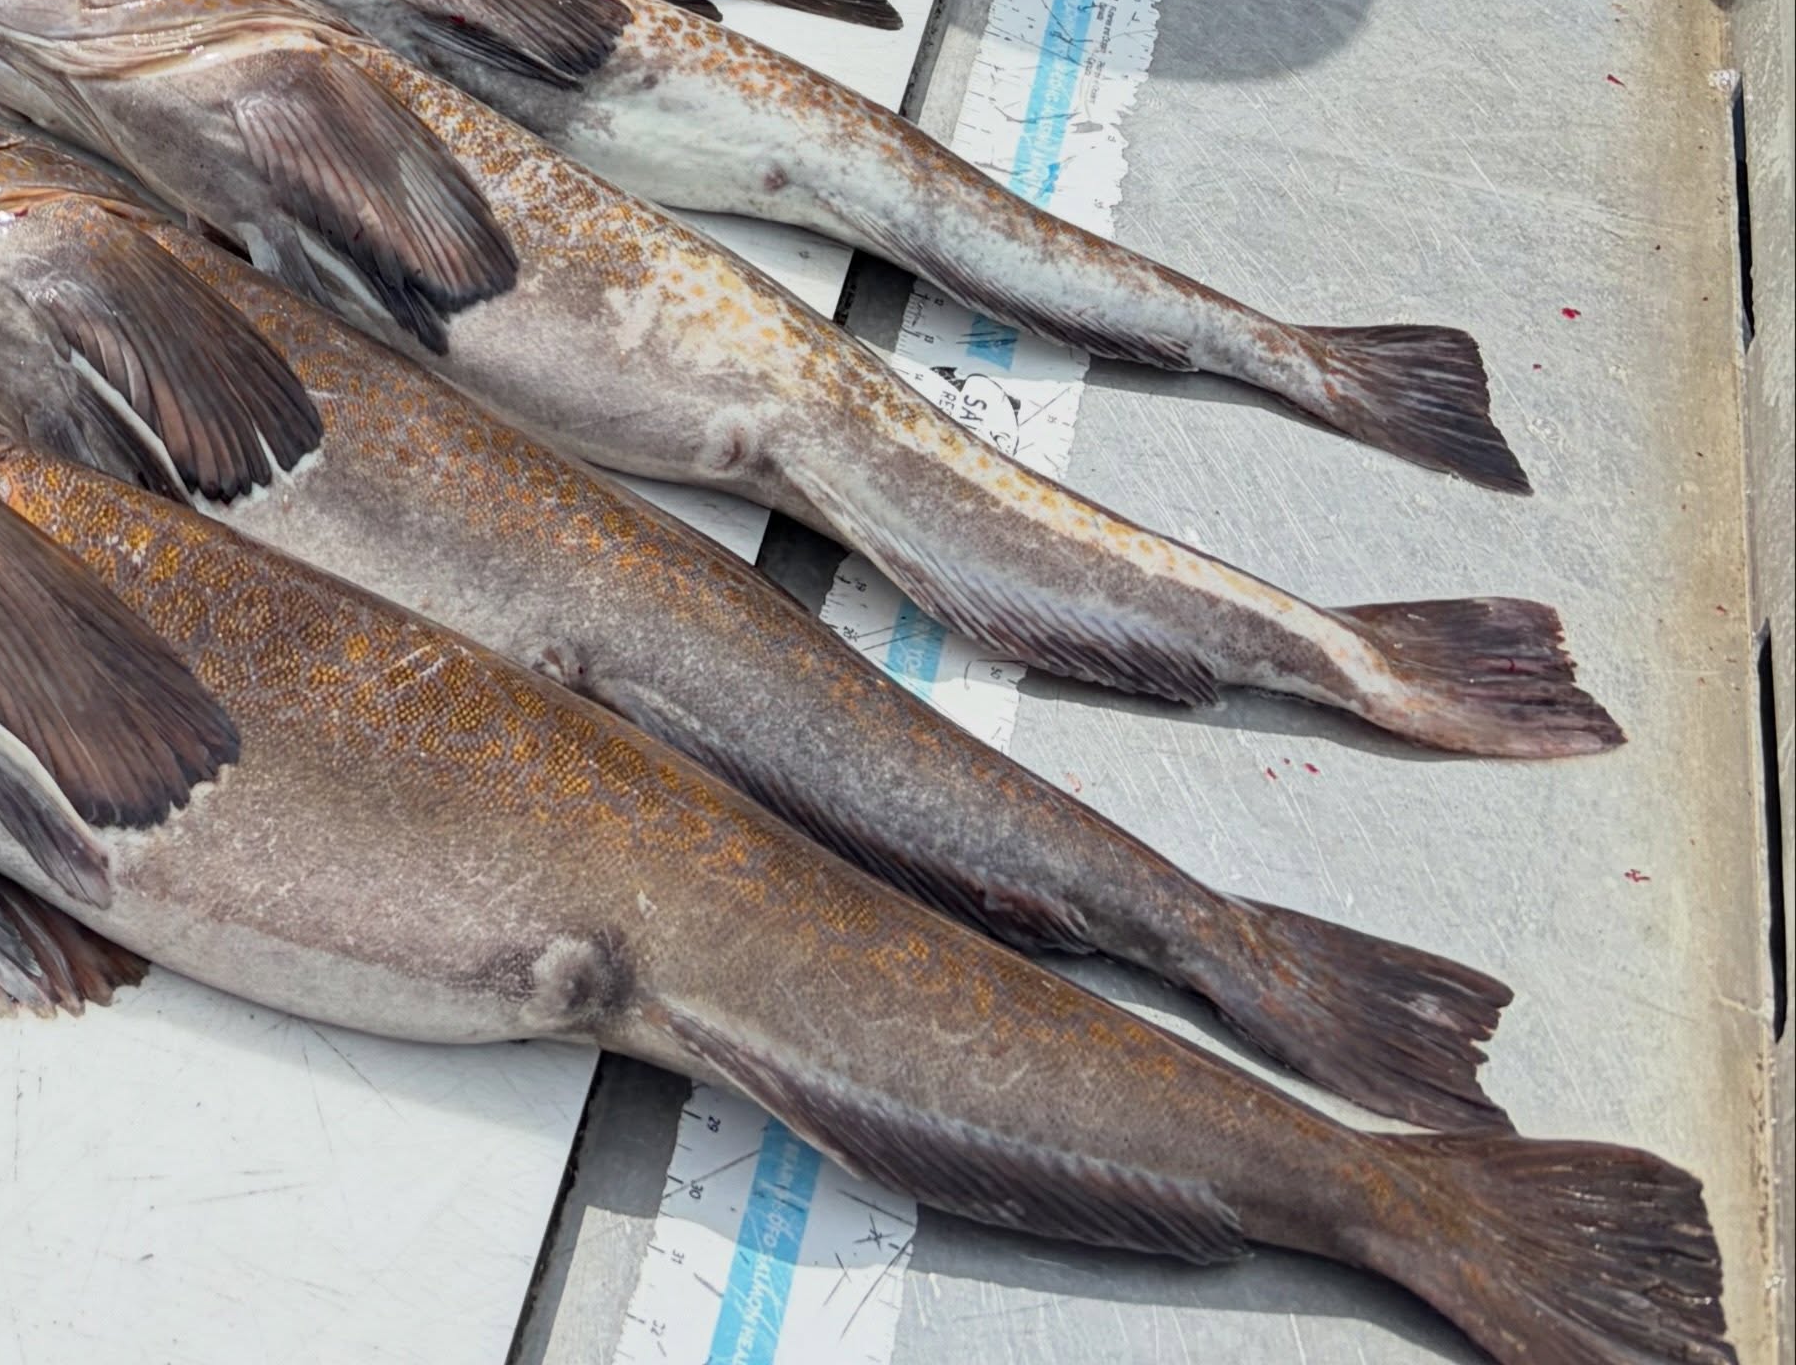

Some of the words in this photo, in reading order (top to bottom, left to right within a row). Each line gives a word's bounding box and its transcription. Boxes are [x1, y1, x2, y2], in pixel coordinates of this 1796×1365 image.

[706, 1115, 722, 1133] 29
[689, 1180, 705, 1200] 30
[672, 1249, 686, 1265] 31
